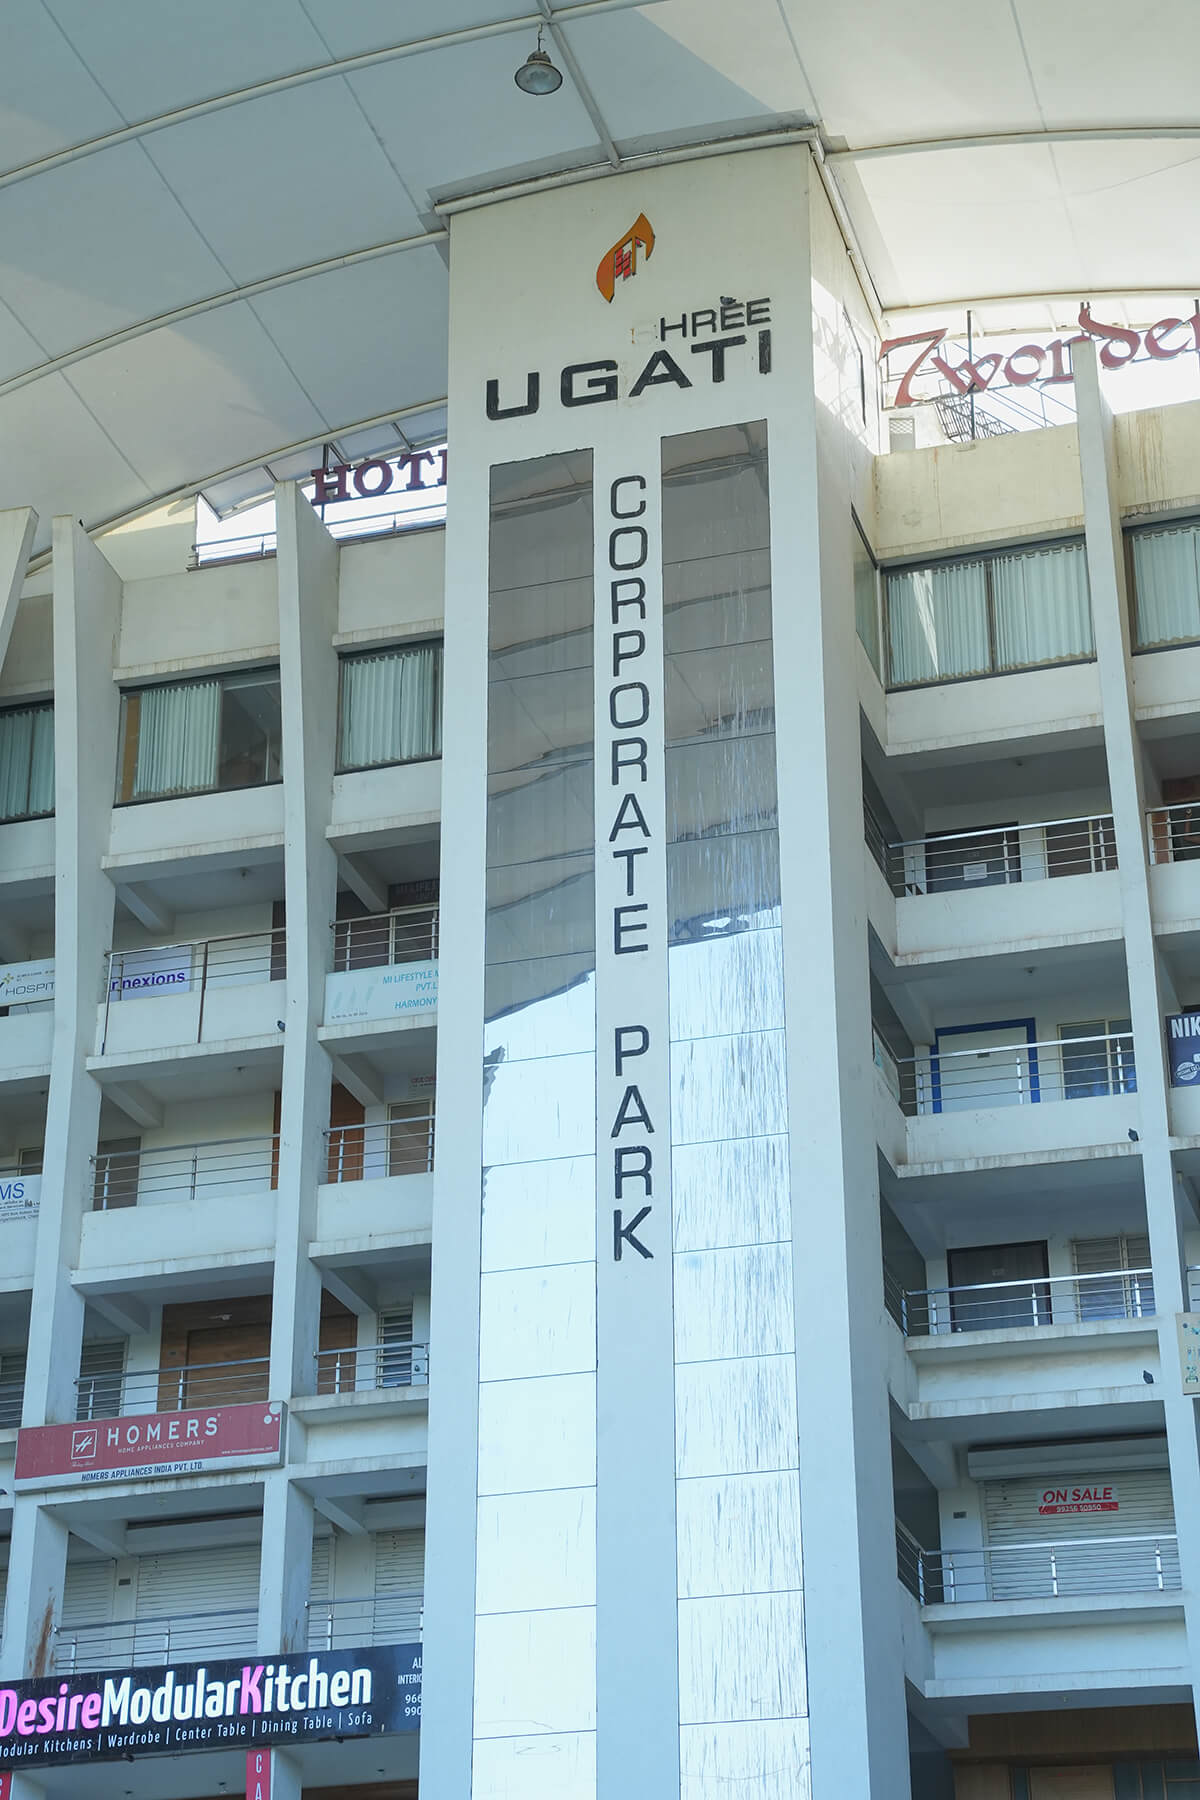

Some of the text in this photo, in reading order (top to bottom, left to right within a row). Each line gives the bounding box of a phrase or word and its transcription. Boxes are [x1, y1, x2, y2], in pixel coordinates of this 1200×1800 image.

[486, 329, 771, 420] UGATI
[609, 475, 655, 1261] CORPORATE PARK
[122, 972, 185, 989] nexions
[394, 970, 432, 983] LIFESTYLE
[394, 997, 437, 1009] HARMONY
[107, 1416, 218, 1447] HOMERS
[137, 1442, 174, 1452] APPLIANCES
[175, 1439, 206, 1448] COMPANY
[81, 1471, 109, 1481] HOMERS
[111, 1466, 153, 1479] APPLIANCES
[154, 1463, 172, 1474] INDIA
[1043, 1487, 1113, 1503] ON SALE
[44, 1738, 92, 1753] Kitchens
[108, 1731, 160, 1748] Wardrobe
[175, 1727, 212, 1741] Center
[217, 1722, 246, 1737] Table
[261, 1720, 298, 1734] Dining
[304, 1715, 333, 1730] Table
[348, 1711, 373, 1726] Sofa
